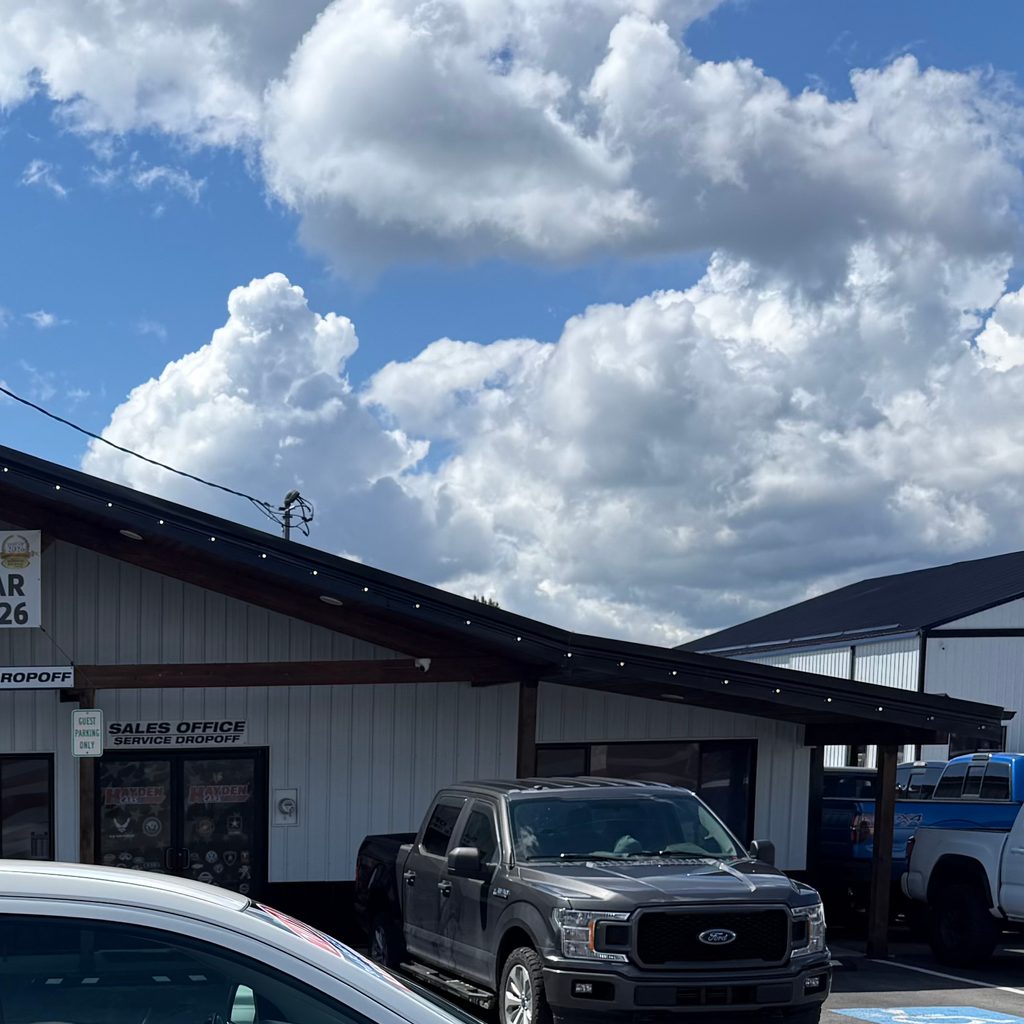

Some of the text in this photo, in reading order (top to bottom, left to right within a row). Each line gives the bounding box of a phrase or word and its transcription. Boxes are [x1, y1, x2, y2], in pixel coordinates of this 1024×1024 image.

[78, 716, 96, 726] GUEST
[108, 720, 246, 734] SALES OFFICE
[75, 728, 100, 737] PARKING
[113, 734, 241, 746] SERVICE DROPOFF
[79, 741, 95, 750] ONLY
[707, 932, 728, 942] Ford
